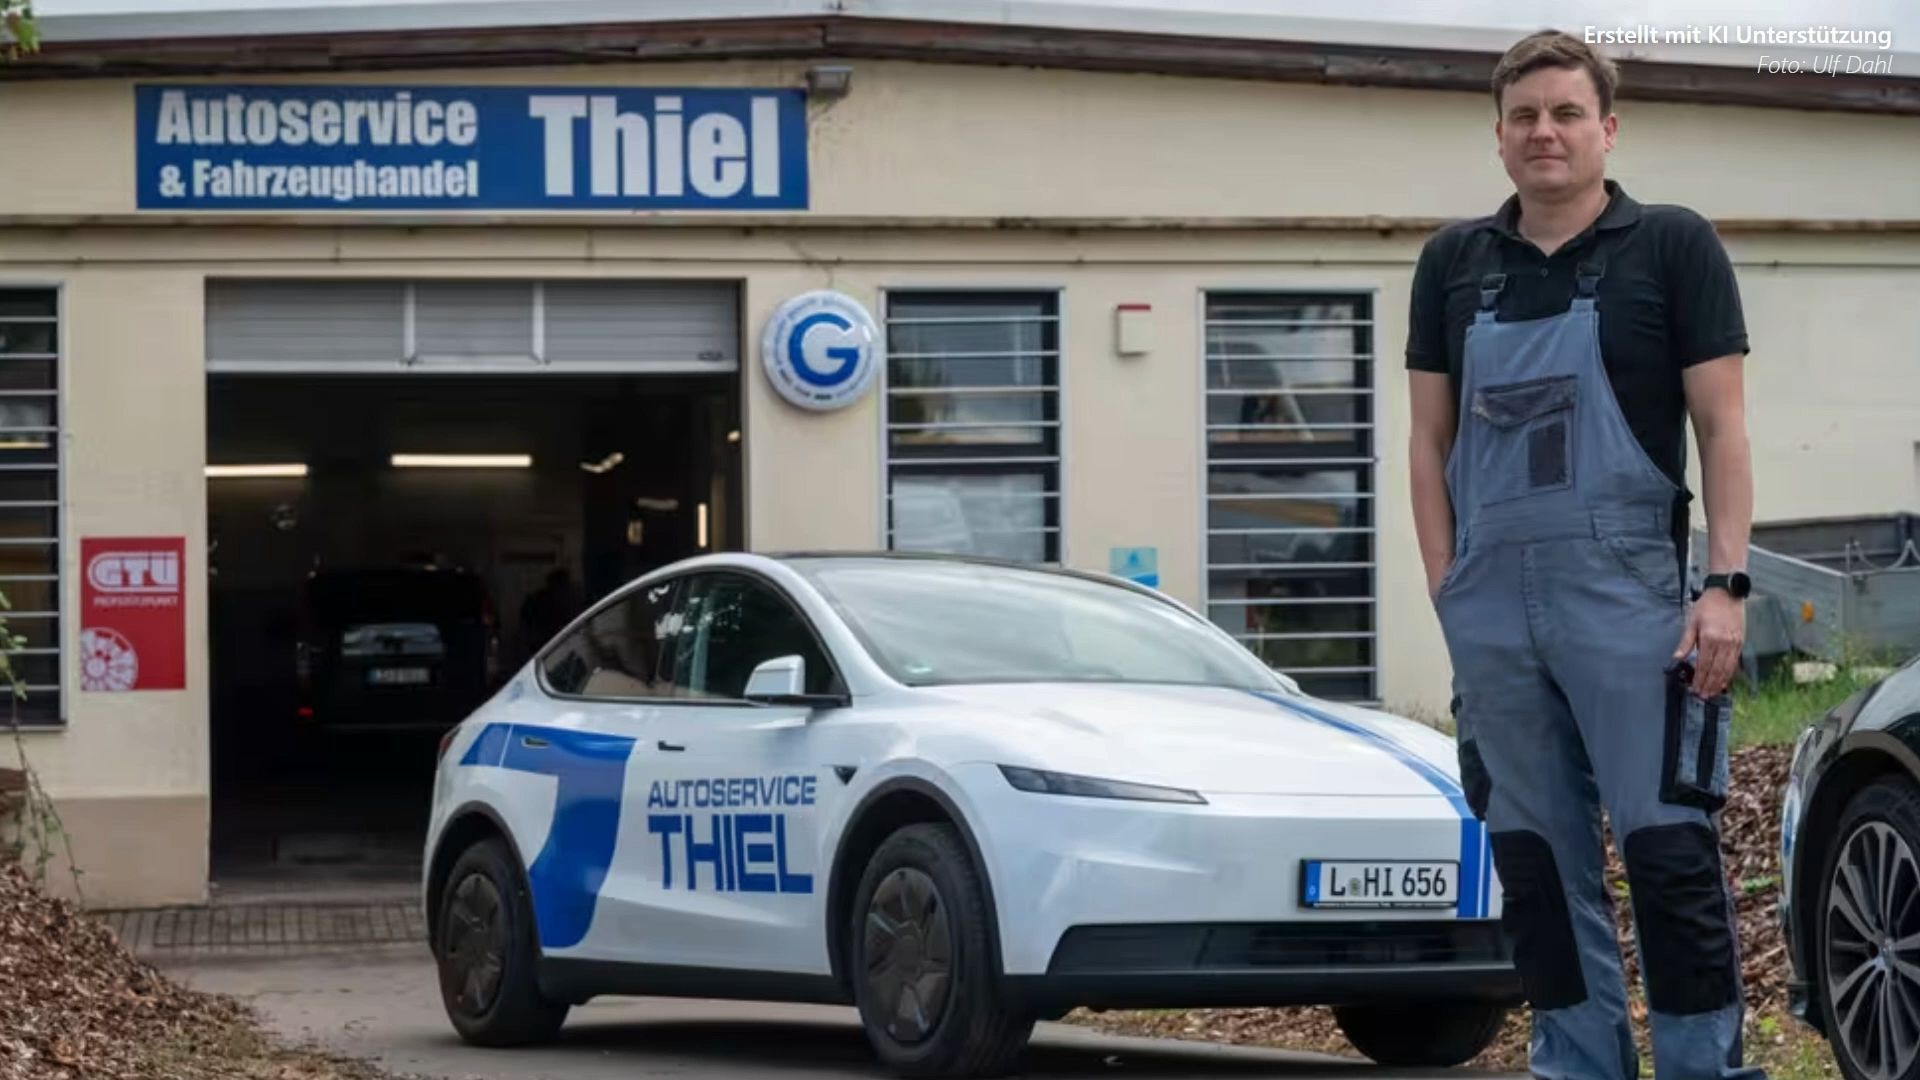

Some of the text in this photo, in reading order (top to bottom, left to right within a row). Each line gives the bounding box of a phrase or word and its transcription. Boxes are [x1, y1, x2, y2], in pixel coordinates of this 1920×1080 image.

[156, 91, 478, 146] Autoservice
[529, 95, 780, 198] Thiel
[159, 160, 478, 200] & Fahrzeughandel
[647, 776, 817, 808] AUTOSERVICE
[647, 813, 814, 894] THIEL
[1329, 867, 1447, 897] L HI 656
